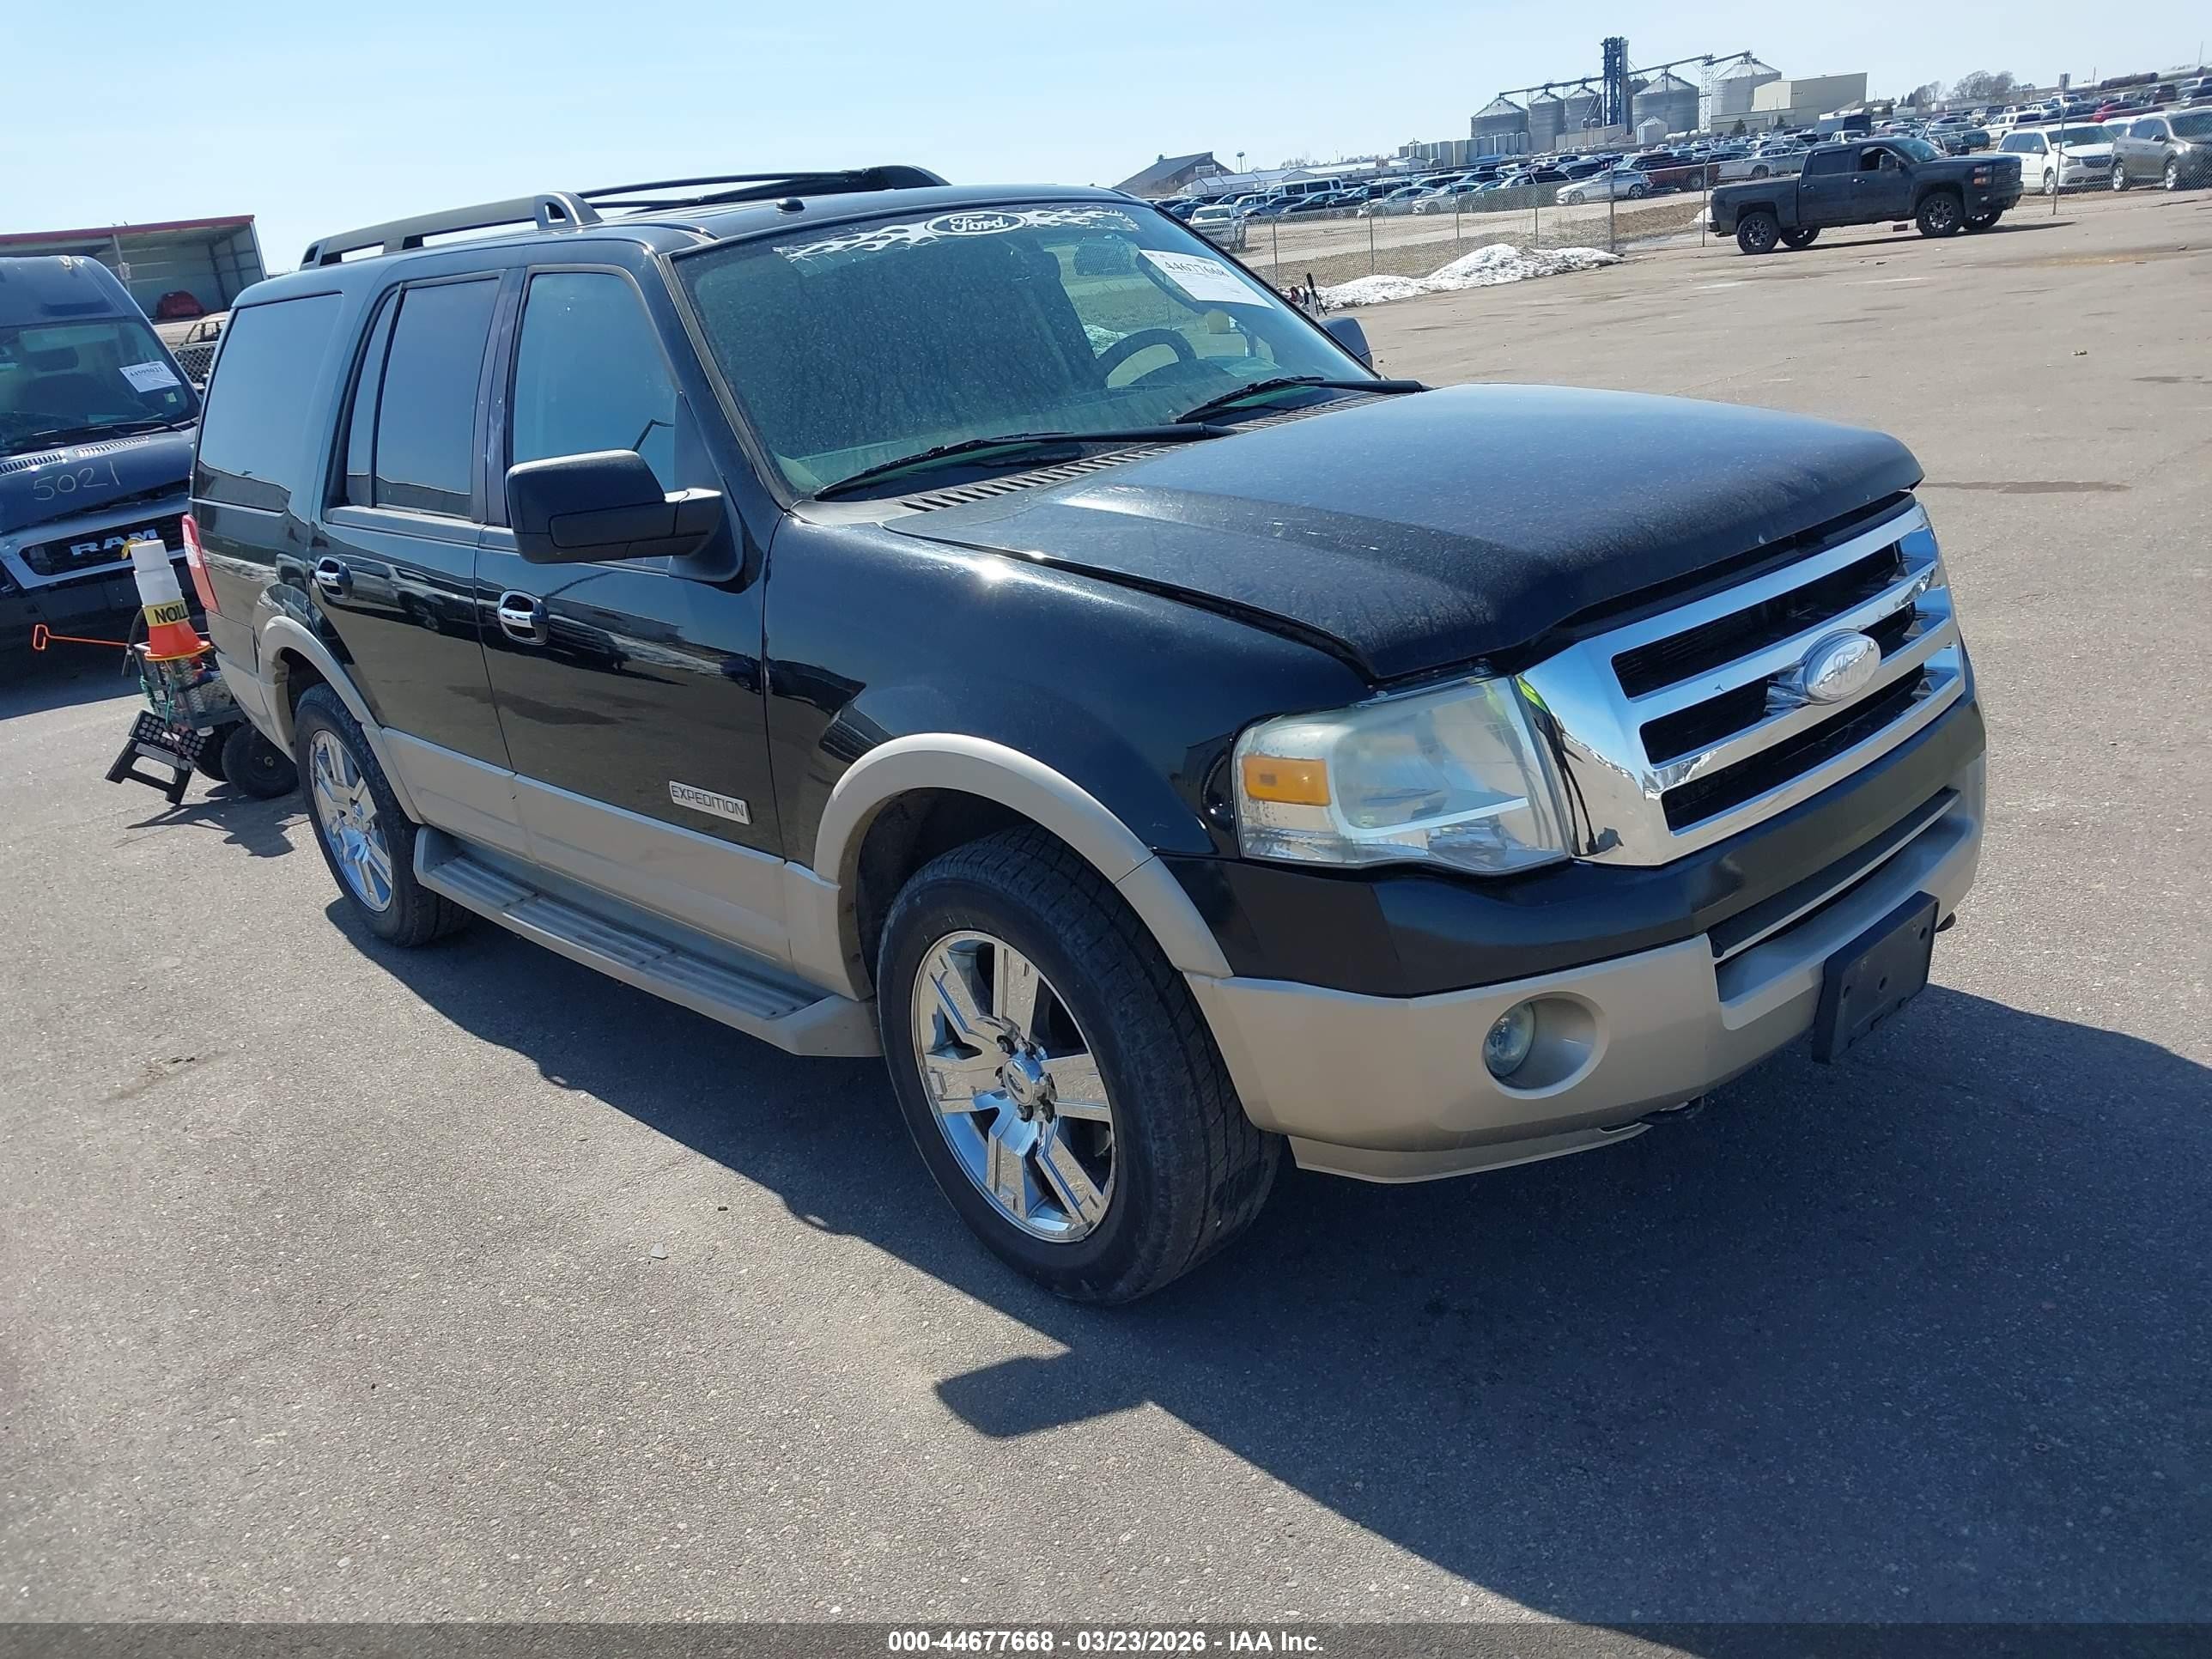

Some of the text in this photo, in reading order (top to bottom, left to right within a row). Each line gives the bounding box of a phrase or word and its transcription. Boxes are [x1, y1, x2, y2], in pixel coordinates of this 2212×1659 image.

[949, 215, 1008, 233] Ford
[33, 461, 121, 501] 5021
[70, 528, 159, 556] RAM
[671, 785, 745, 817] EXPEDITION
